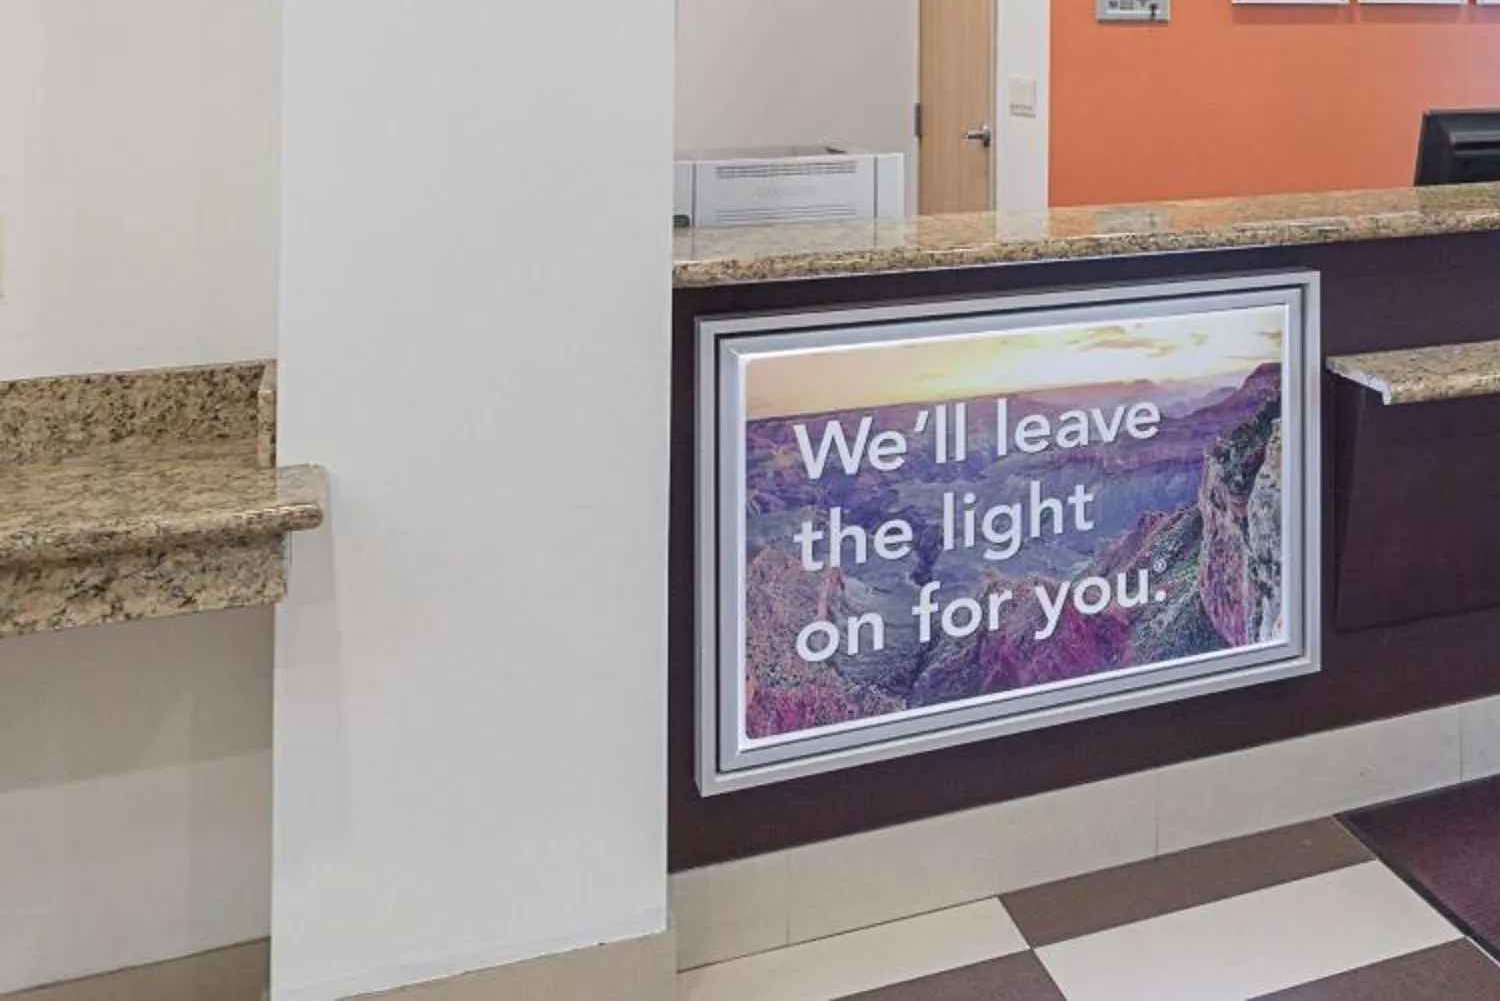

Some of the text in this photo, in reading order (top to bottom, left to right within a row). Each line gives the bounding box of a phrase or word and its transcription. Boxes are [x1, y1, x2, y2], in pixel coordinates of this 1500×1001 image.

[793, 398, 1161, 480] We'll leave
[793, 480, 1095, 571] the light
[796, 612, 885, 662] on
[911, 581, 1014, 644] for
